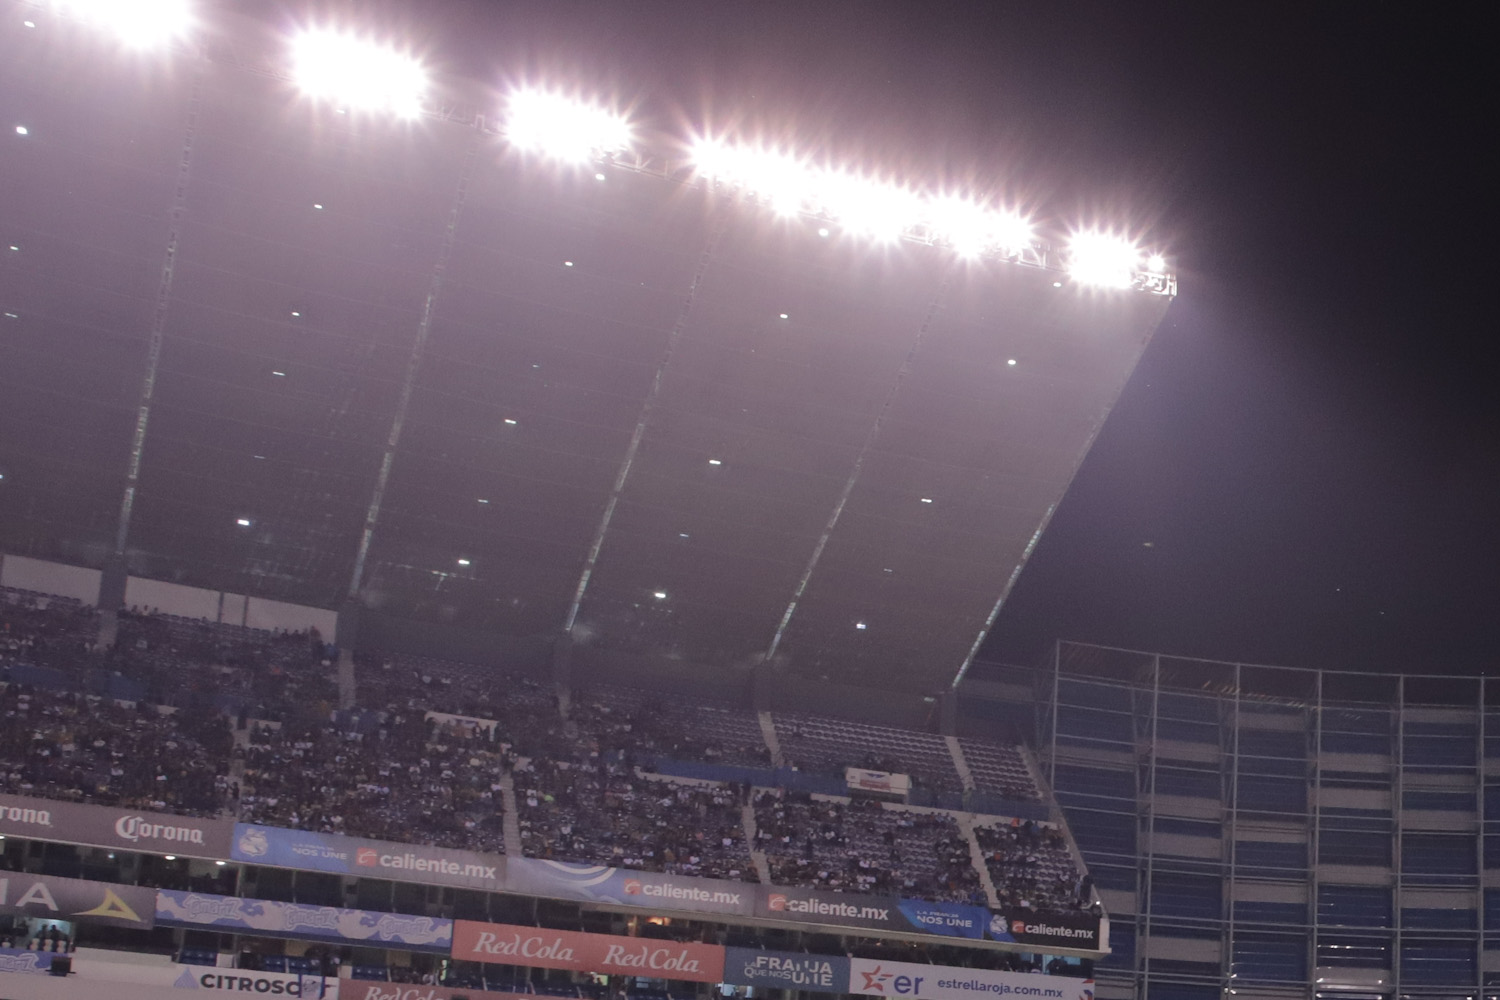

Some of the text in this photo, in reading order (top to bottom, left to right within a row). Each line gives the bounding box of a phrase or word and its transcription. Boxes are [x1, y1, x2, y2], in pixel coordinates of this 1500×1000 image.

[115, 815, 203, 842] Corona
[379, 853, 496, 880] caliente.mx
[643, 883, 740, 904] caliente.mx
[788, 897, 889, 921] caliente.mx
[916, 915, 973, 928] NOS UNE
[1025, 921, 1094, 940] caliente.mx
[894, 975, 924, 995] er
[937, 978, 1063, 998] estrellaroja.com.mx
